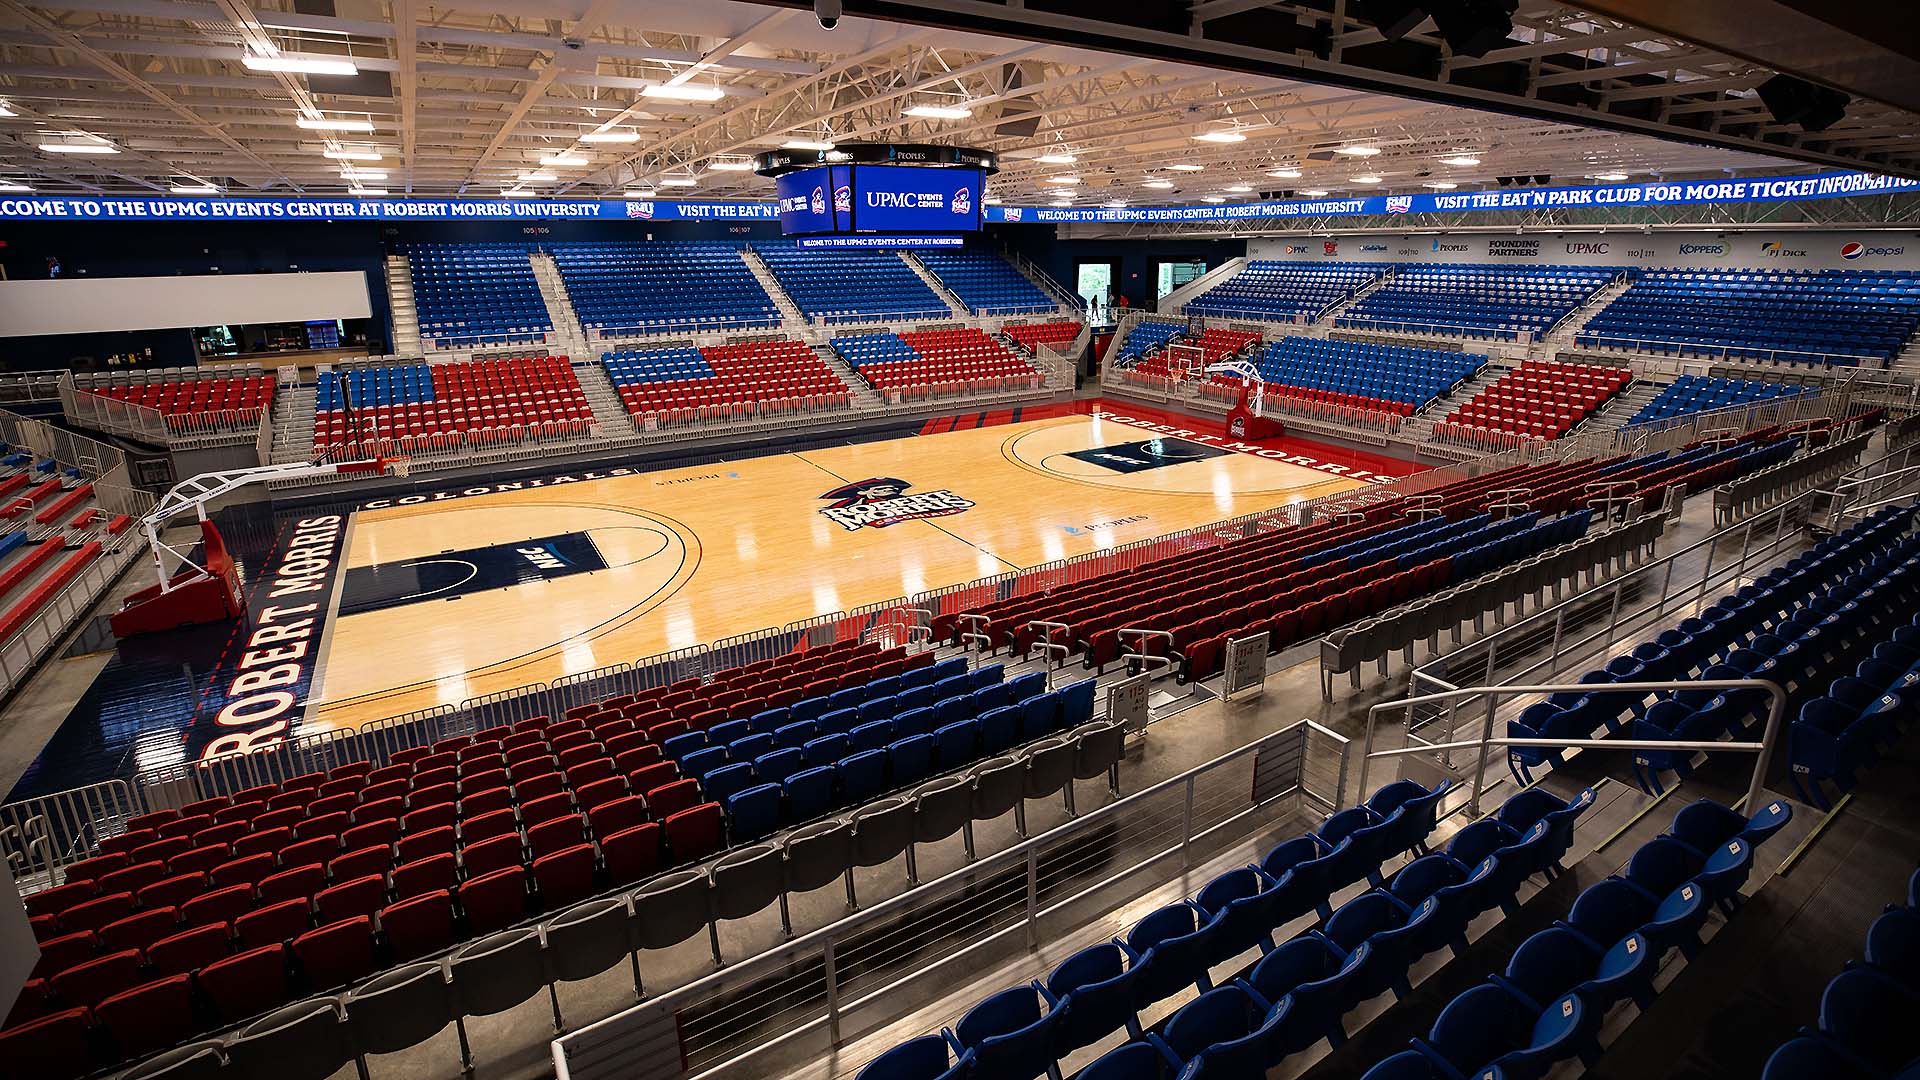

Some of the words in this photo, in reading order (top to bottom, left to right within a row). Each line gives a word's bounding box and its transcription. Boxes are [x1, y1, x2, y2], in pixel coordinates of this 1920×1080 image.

[897, 152, 926, 160] PEOPLES
[1434, 196, 1471, 209] VISIT
[1470, 195, 1499, 208] THE
[1501, 191, 1548, 207] EAT'N
[1548, 189, 1594, 205] PARK
[1595, 187, 1641, 203] CLUB
[1644, 185, 1682, 202] FOR
[1684, 182, 1746, 200] MORE
[1749, 178, 1819, 198] TICKET
[1817, 173, 1918, 195] INFORMATIO
[866, 192, 917, 208] UPMC
[1386, 196, 1412, 212] RMU
[0, 200, 68, 216] COME
[69, 201, 100, 216] TO
[102, 201, 147, 216] THE
[149, 202, 208, 216] UPMC
[210, 202, 284, 216] EVENTS
[286, 202, 356, 216] CENTER
[358, 202, 381, 216] AT
[384, 203, 448, 216] ROBERT
[450, 203, 511, 216] MORRIS
[513, 203, 601, 216] UNIVERSITY
[626, 201, 655, 217] RMU
[677, 204, 712, 216] VISIT
[714, 205, 736, 216] THE
[738, 203, 772, 217] EAT'N
[1037, 210, 1080, 220] WELCOME
[1081, 210, 1094, 220] TO
[1096, 210, 1116, 220] THE
[1117, 210, 1147, 220] UPMC
[1147, 209, 1183, 220] EVENTS
[1183, 208, 1213, 219] CENTER
[1213, 208, 1225, 218] AT
[1225, 205, 1262, 217] ROBERT
[1261, 203, 1300, 216] MORRIS
[1300, 200, 1366, 214] UNIVERSITY
[847, 238, 867, 246] UPMC
[868, 238, 896, 246] EVENTS
[1440, 244, 1468, 252] PEOPLES
[1488, 240, 1540, 248] FOUNDING
[1566, 243, 1609, 255] UPMC
[1678, 243, 1723, 255] KOPPERS
[1293, 246, 1308, 254] PNC
[1488, 249, 1539, 257] PARTNERS
[1865, 246, 1904, 256] pepsi
[1089, 411, 1222, 441] ROBERT
[1222, 442, 1401, 485] MORRIS
[365, 468, 633, 510] COLONIALS
[820, 489, 953, 519] ROBERT
[835, 497, 977, 532] MORRIS
[199, 602, 318, 768] ROBERT
[268, 515, 341, 598] MORRIS
[1130, 684, 1145, 699] 115
